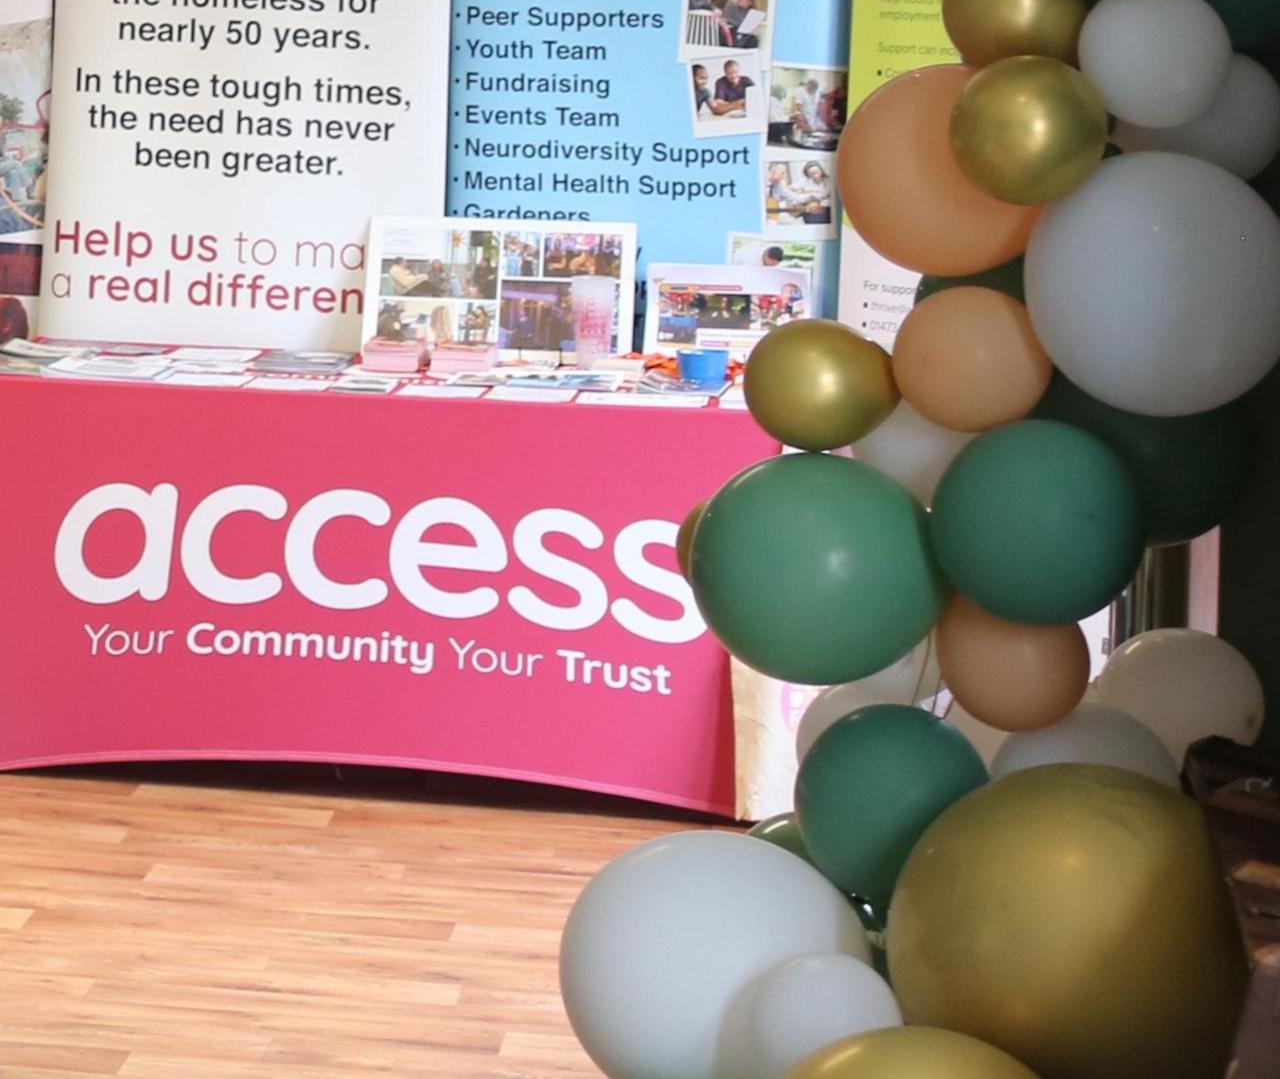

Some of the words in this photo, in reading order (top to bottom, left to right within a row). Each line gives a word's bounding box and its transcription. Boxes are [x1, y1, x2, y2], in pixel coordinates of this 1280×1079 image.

[118, 17, 215, 51] nearly
[225, 20, 263, 47] 50
[273, 26, 371, 54] years.
[466, 6, 519, 26] Peer
[527, 7, 665, 32] Supporters
[466, 39, 534, 60] Youth
[543, 40, 608, 61] Team
[75, 67, 101, 93] In
[112, 69, 200, 98] these
[209, 73, 302, 108] tough
[314, 77, 412, 112] times,
[466, 72, 611, 99] Fundraising
[88, 104, 138, 131] the
[148, 106, 225, 134] need
[236, 110, 293, 138] has
[304, 116, 396, 142] never
[466, 105, 547, 127] Events
[555, 107, 620, 128] Team
[134, 141, 211, 170] been
[221, 149, 344, 178] greater.
[465, 138, 644, 166] Neurodiversity
[651, 142, 751, 168] Support
[464, 171, 543, 192] Mental
[553, 173, 630, 195] Health
[639, 176, 737, 202] Support
[53, 219, 153, 266] Help
[170, 231, 218, 263] us
[234, 230, 277, 265] to
[295, 239, 365, 271] ma
[51, 272, 72, 299] a
[87, 270, 171, 305] real
[187, 273, 364, 315] differen
[54, 482, 708, 644] access
[83, 623, 174, 656] Your
[186, 622, 435, 674] Community
[448, 637, 544, 677] Your
[556, 648, 672, 695] Trust
